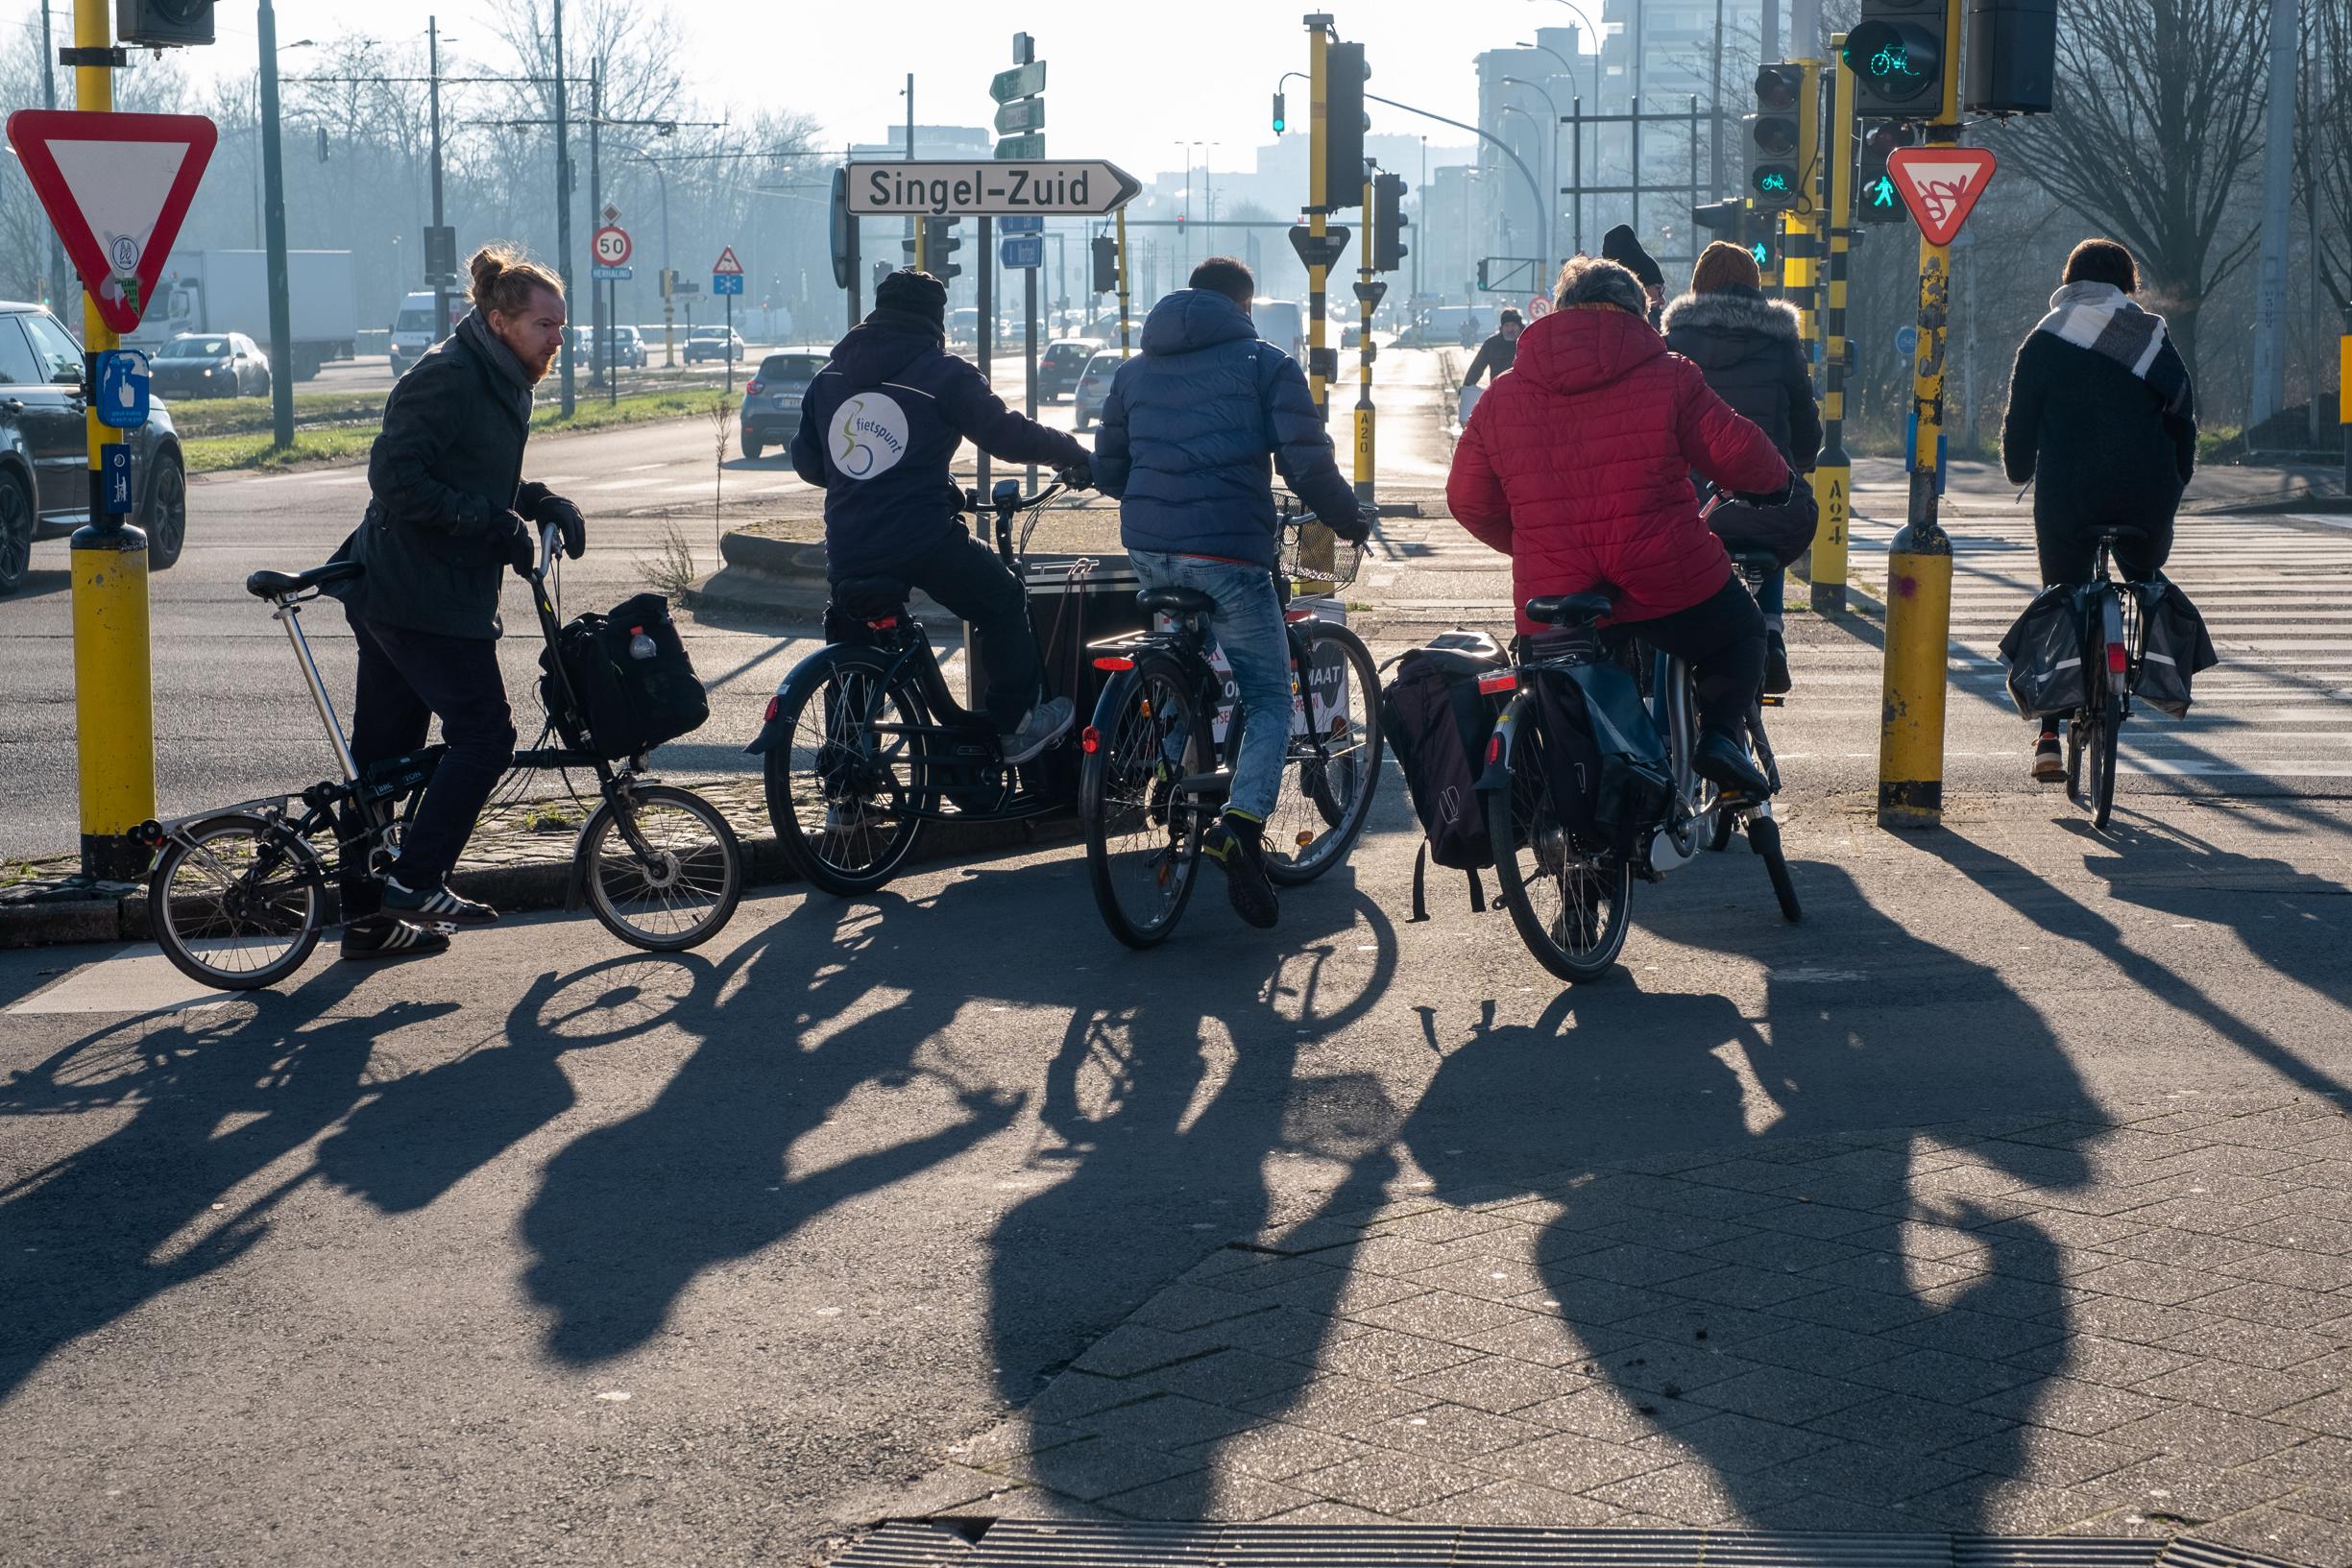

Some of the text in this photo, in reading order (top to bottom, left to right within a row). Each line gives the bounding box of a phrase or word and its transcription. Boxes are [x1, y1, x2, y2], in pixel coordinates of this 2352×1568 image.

[869, 170, 1089, 215] Singel-Zuid
[599, 238, 624, 254] 50
[856, 417, 903, 453] fietspunt
[1360, 413, 1369, 453] A20
[1828, 479, 1842, 545] A24
